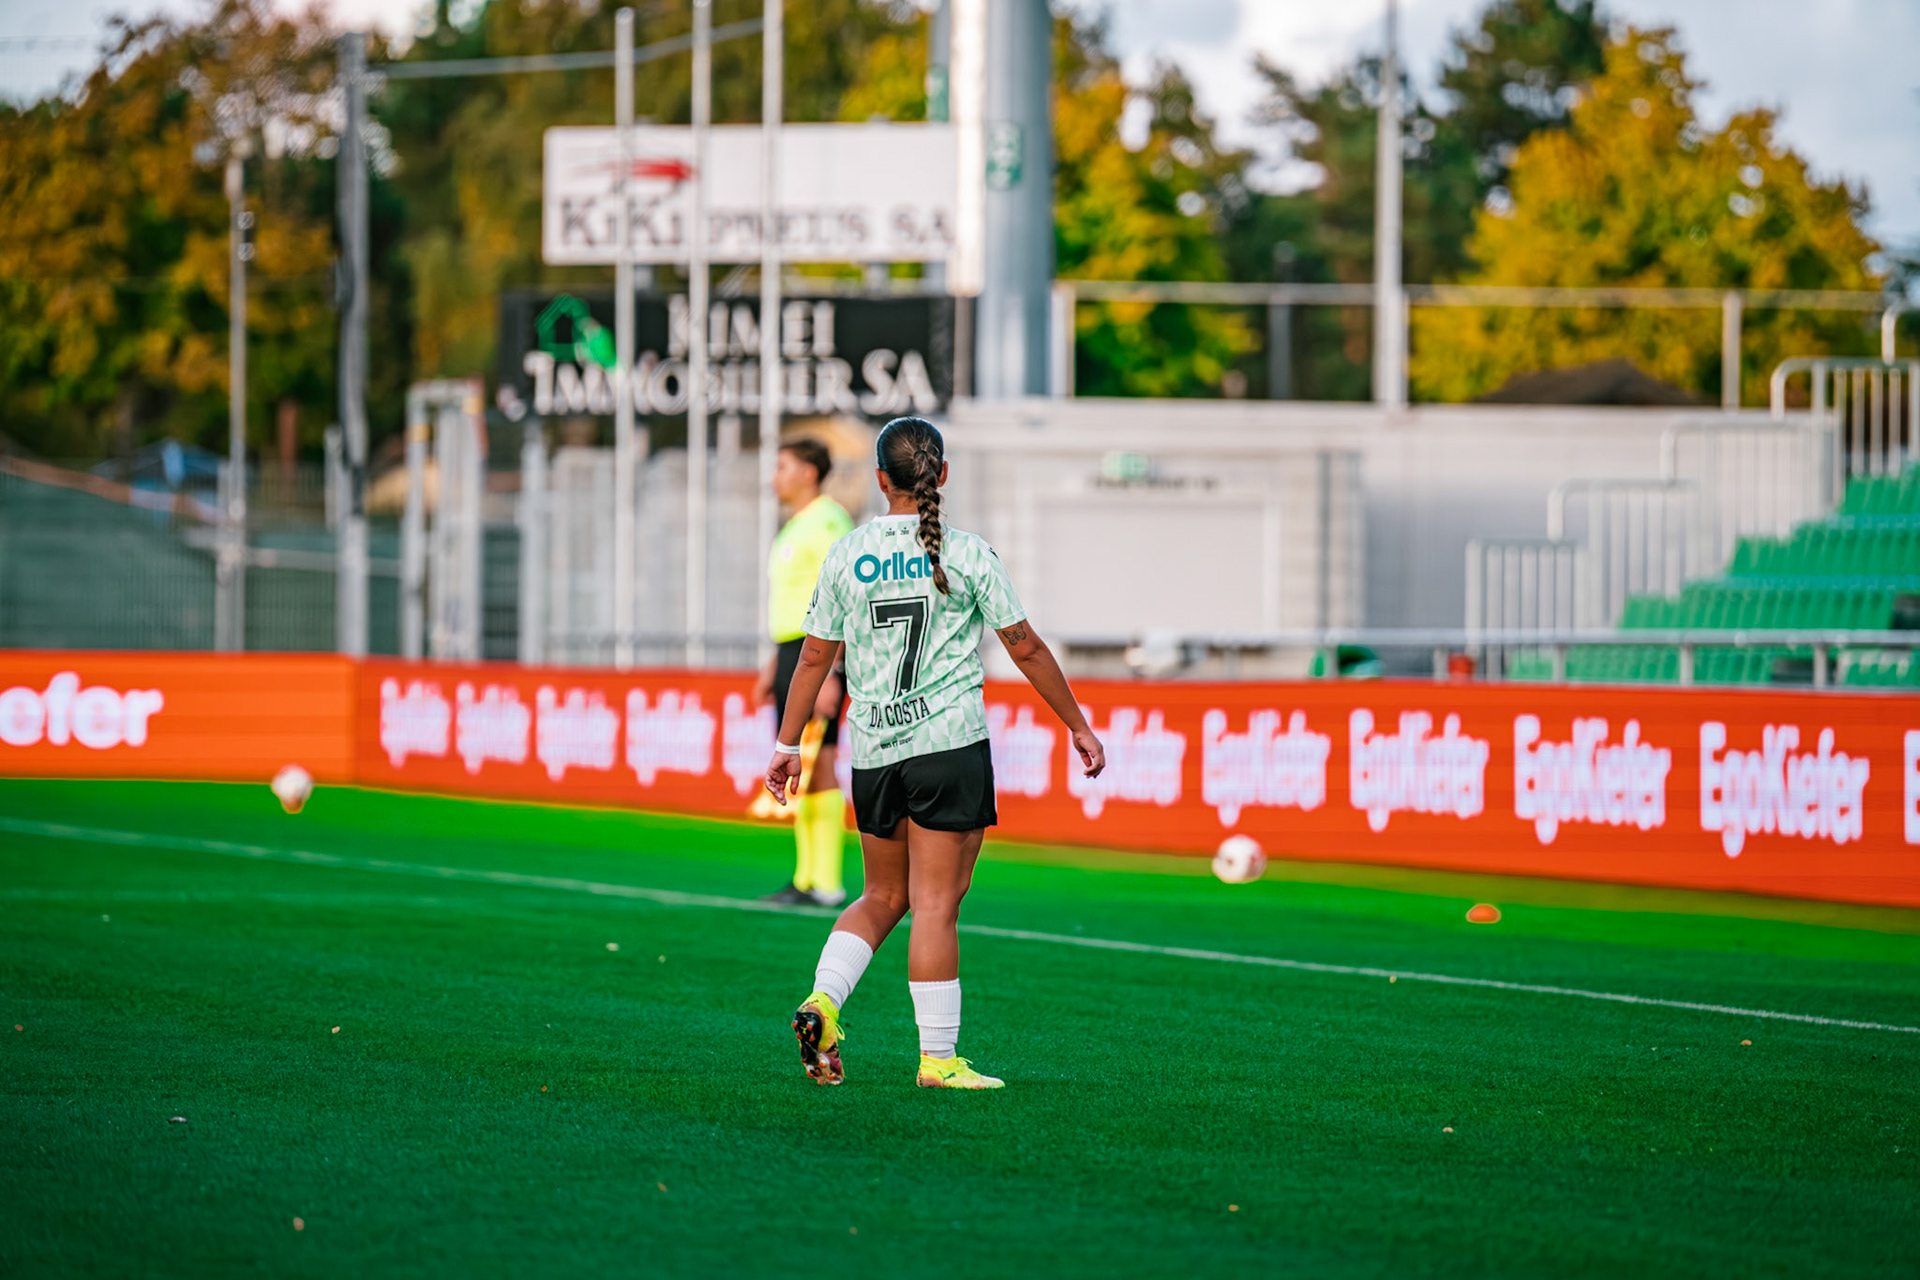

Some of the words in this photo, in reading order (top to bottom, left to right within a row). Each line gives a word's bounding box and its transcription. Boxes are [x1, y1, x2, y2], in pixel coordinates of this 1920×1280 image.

[888, 207, 957, 245] SA
[861, 347, 938, 415] SA
[854, 551, 934, 584] Orllat
[869, 595, 929, 701] 7
[884, 696, 931, 727] COSTA
[1699, 721, 1870, 858] EgoKiefer
